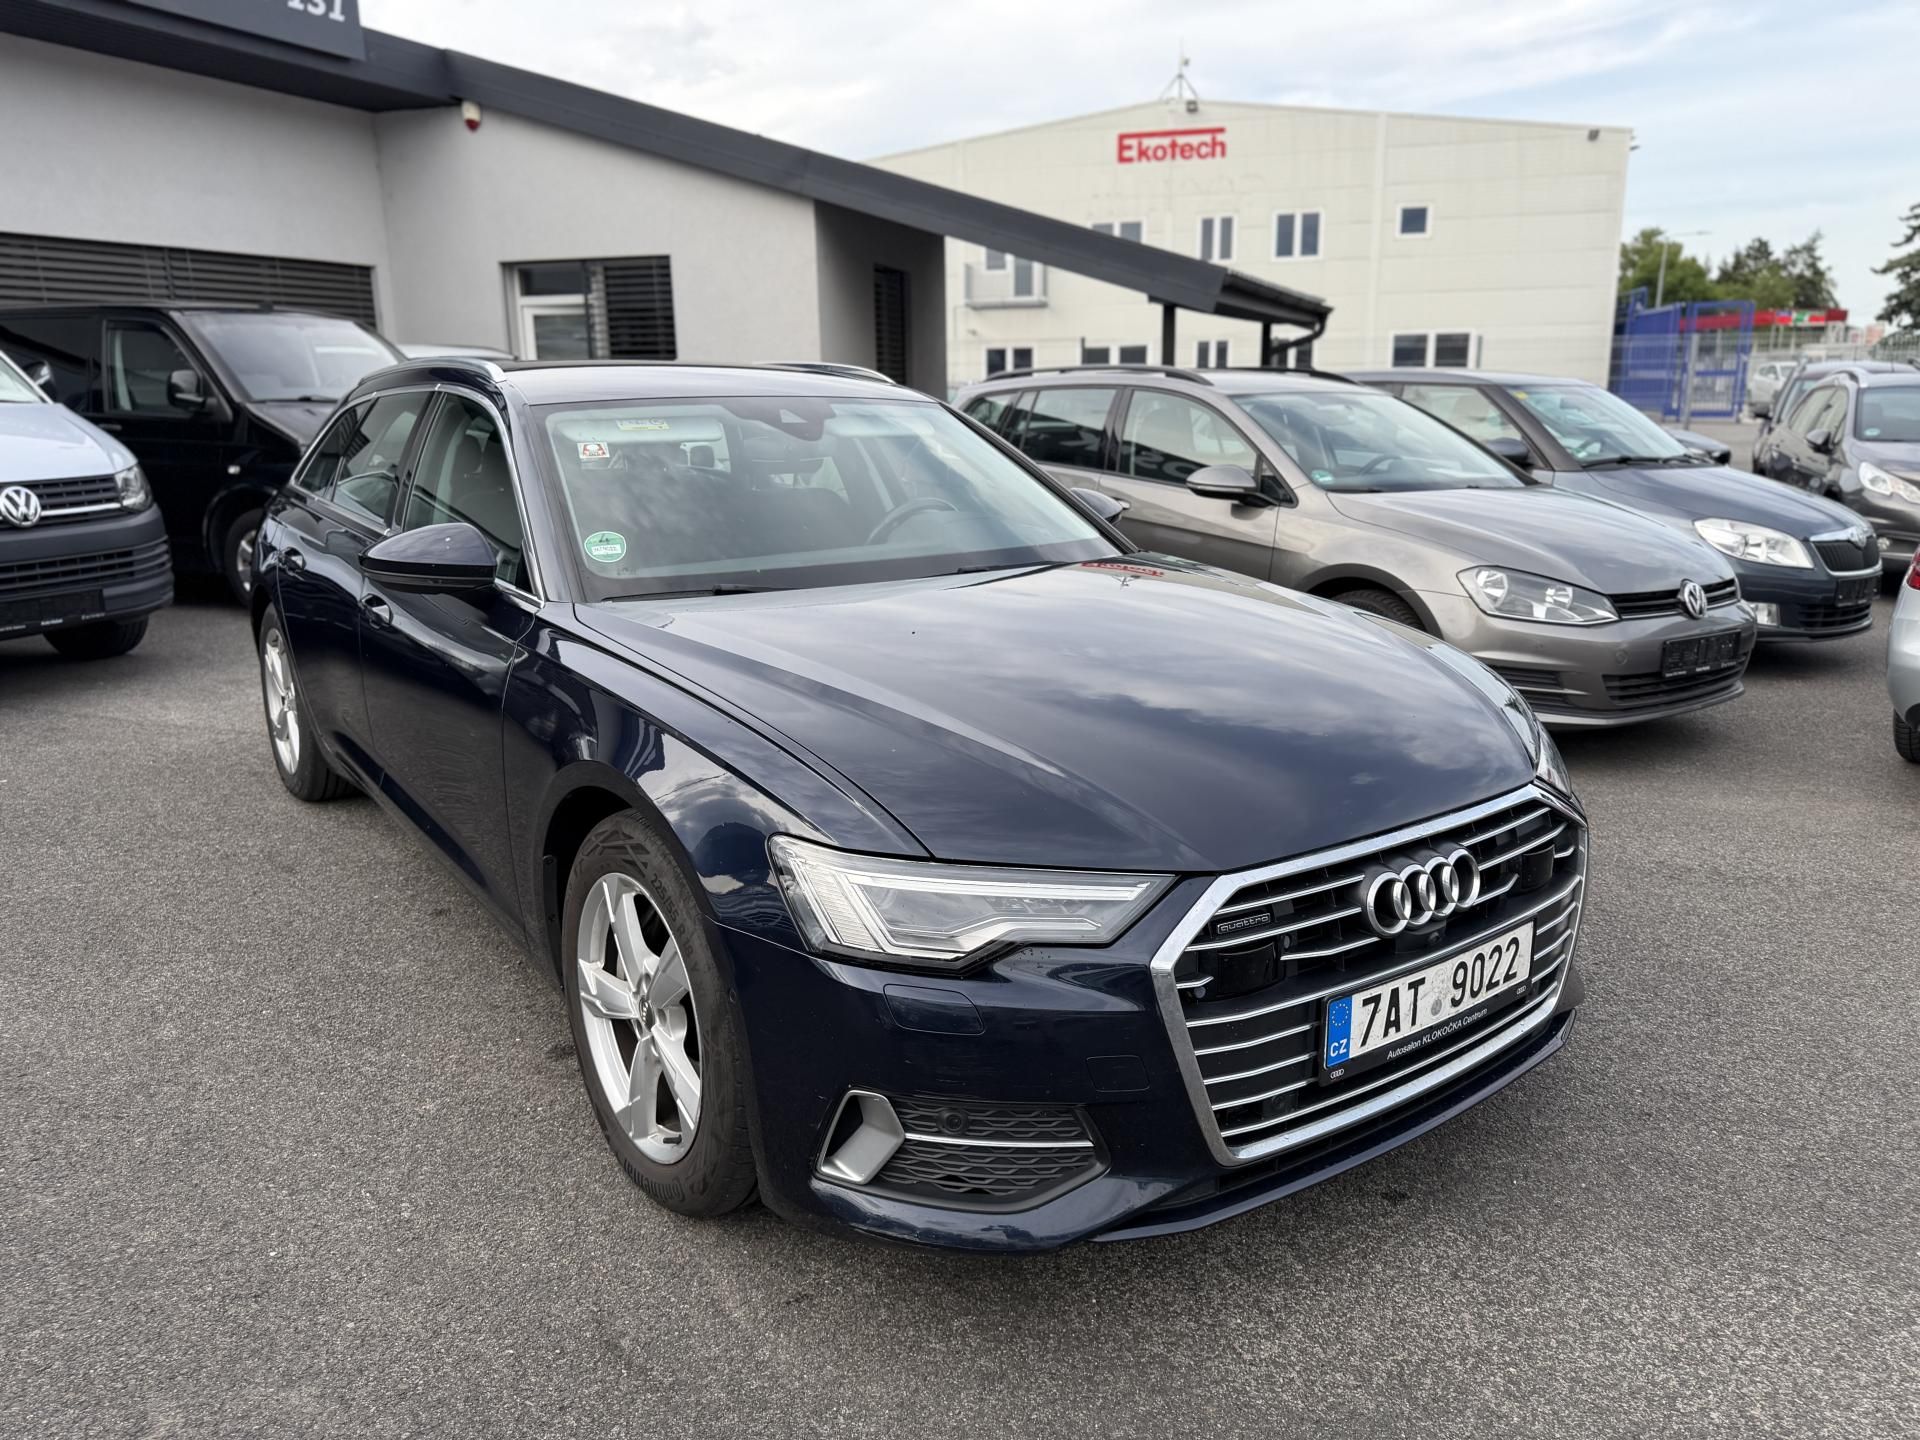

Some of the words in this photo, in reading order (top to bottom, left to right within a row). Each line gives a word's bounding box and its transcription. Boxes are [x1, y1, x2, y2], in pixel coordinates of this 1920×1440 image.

[1117, 127, 1226, 163] Ekotech
[651, 873, 679, 922] 225/55
[1220, 915, 1269, 933] quattro
[1360, 976, 1426, 1048] 7AT
[1450, 936, 1520, 1008] 9022
[1330, 1038, 1348, 1057] CZ
[1386, 1040, 1421, 1060] Autosalon
[1422, 1017, 1463, 1045] KLOKOČKA
[1462, 1008, 1488, 1026] Centrum
